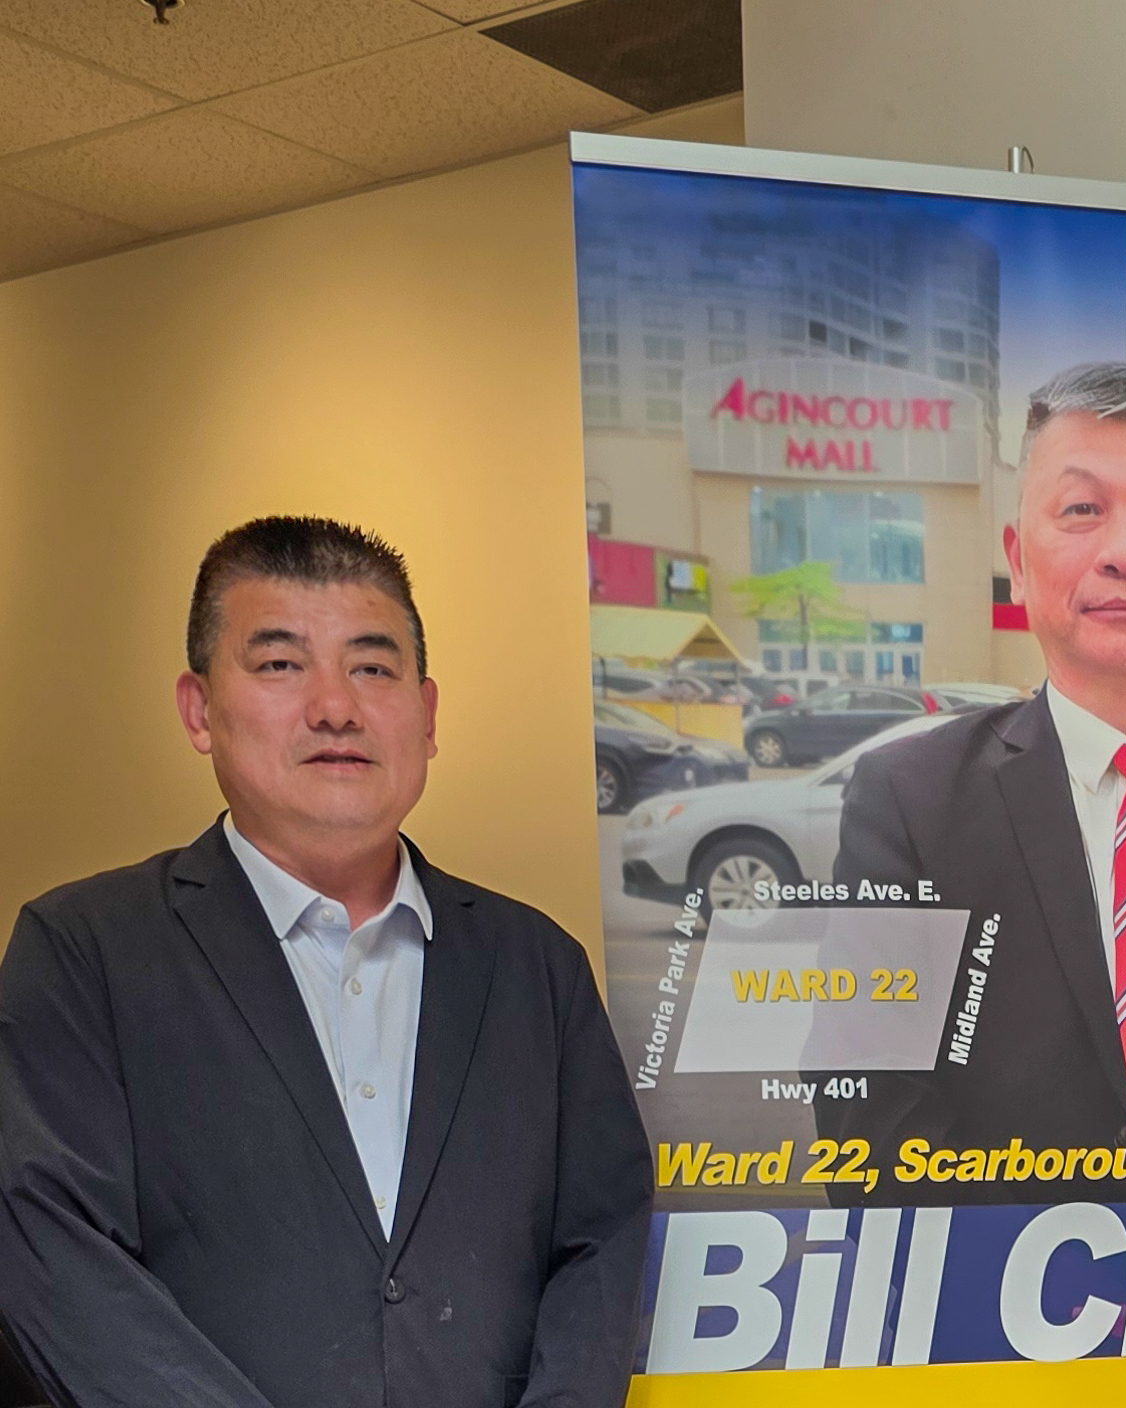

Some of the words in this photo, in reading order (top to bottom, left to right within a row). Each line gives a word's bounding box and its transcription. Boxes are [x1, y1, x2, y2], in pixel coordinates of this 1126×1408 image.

[709, 376, 955, 431] AGINCOURT
[786, 435, 880, 473] MALL
[674, 887, 704, 938] Ave.
[754, 880, 849, 902] Steeles
[857, 879, 911, 901] Ave.
[918, 880, 941, 902] E.
[659, 939, 690, 995] Park
[730, 968, 857, 1002] WARD
[870, 968, 919, 1002] 22
[948, 969, 987, 1065] Midland
[972, 913, 1001, 966] Ave.
[635, 1001, 675, 1091] Victoria
[761, 1079, 817, 1104] Hwy
[824, 1077, 868, 1099] 401
[656, 1140, 793, 1187] Ward
[800, 1138, 879, 1194] 22,
[644, 1206, 953, 1375] Bill
